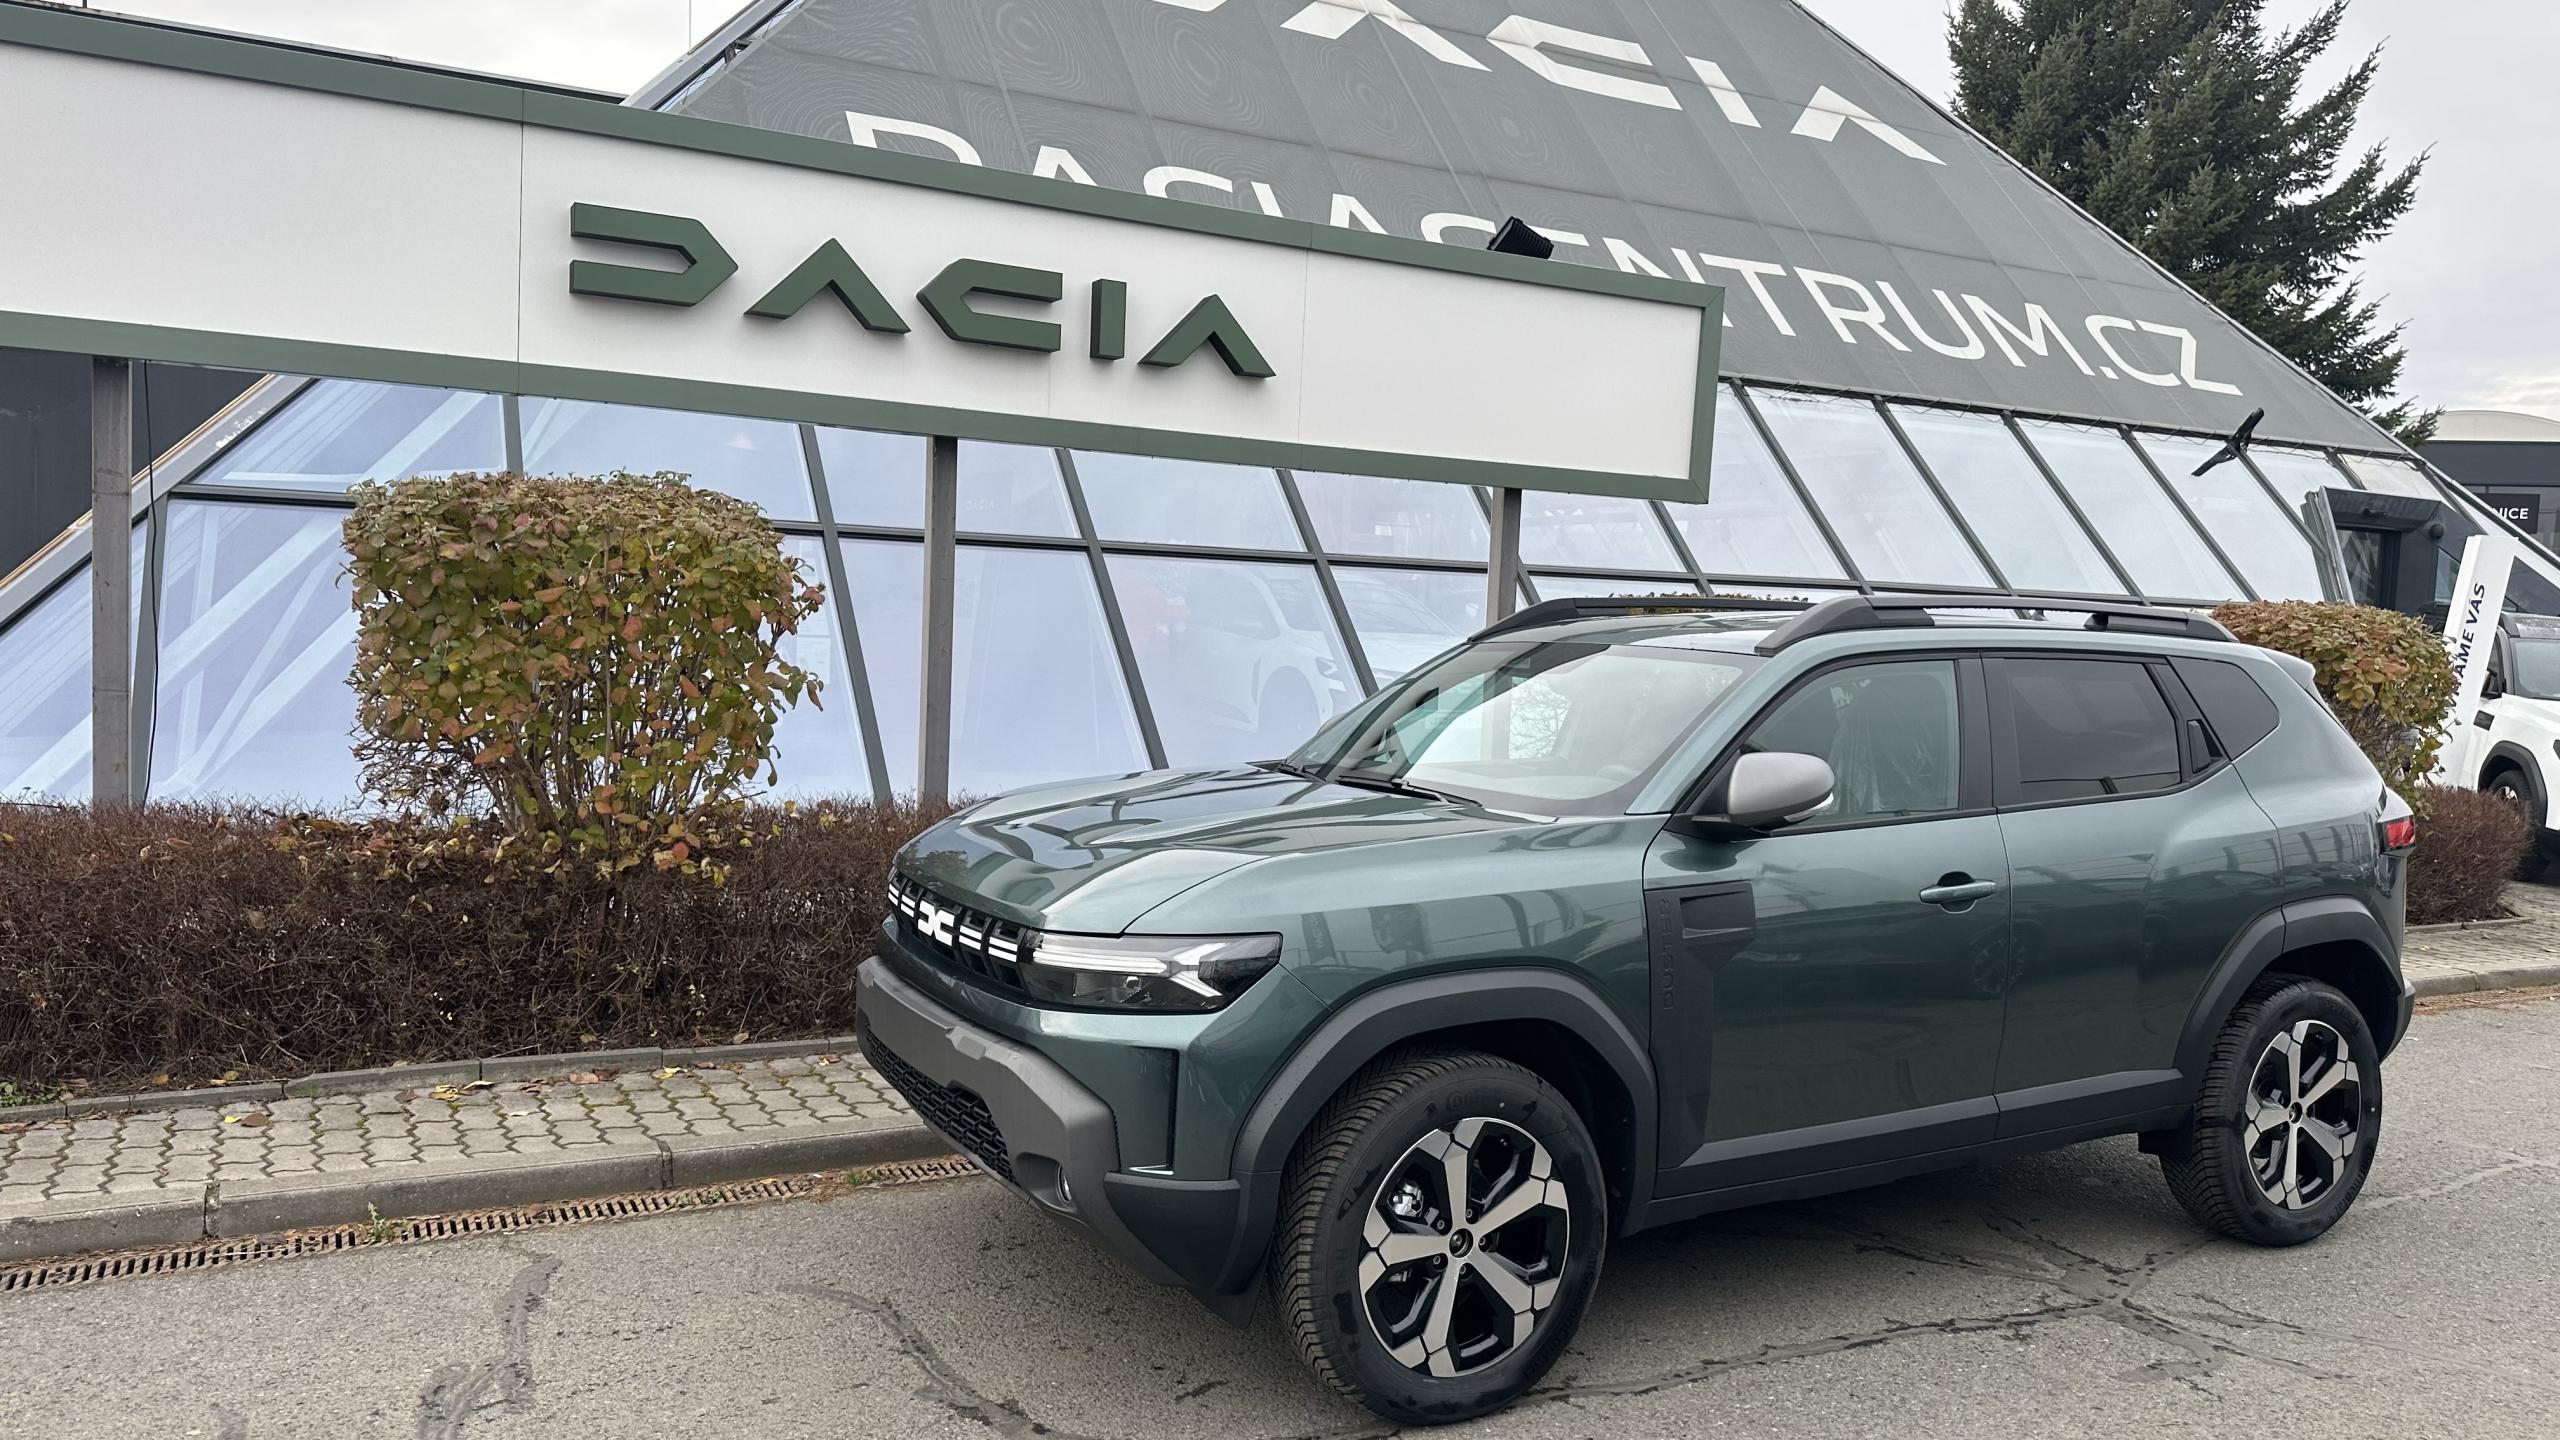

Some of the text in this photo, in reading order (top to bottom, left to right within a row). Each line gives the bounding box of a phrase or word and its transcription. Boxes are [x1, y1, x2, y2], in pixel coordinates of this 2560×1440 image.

[1150, 0, 1946, 166] ACIA
[569, 202, 1276, 379] DACIA
[2465, 582, 2485, 624] VÁS
